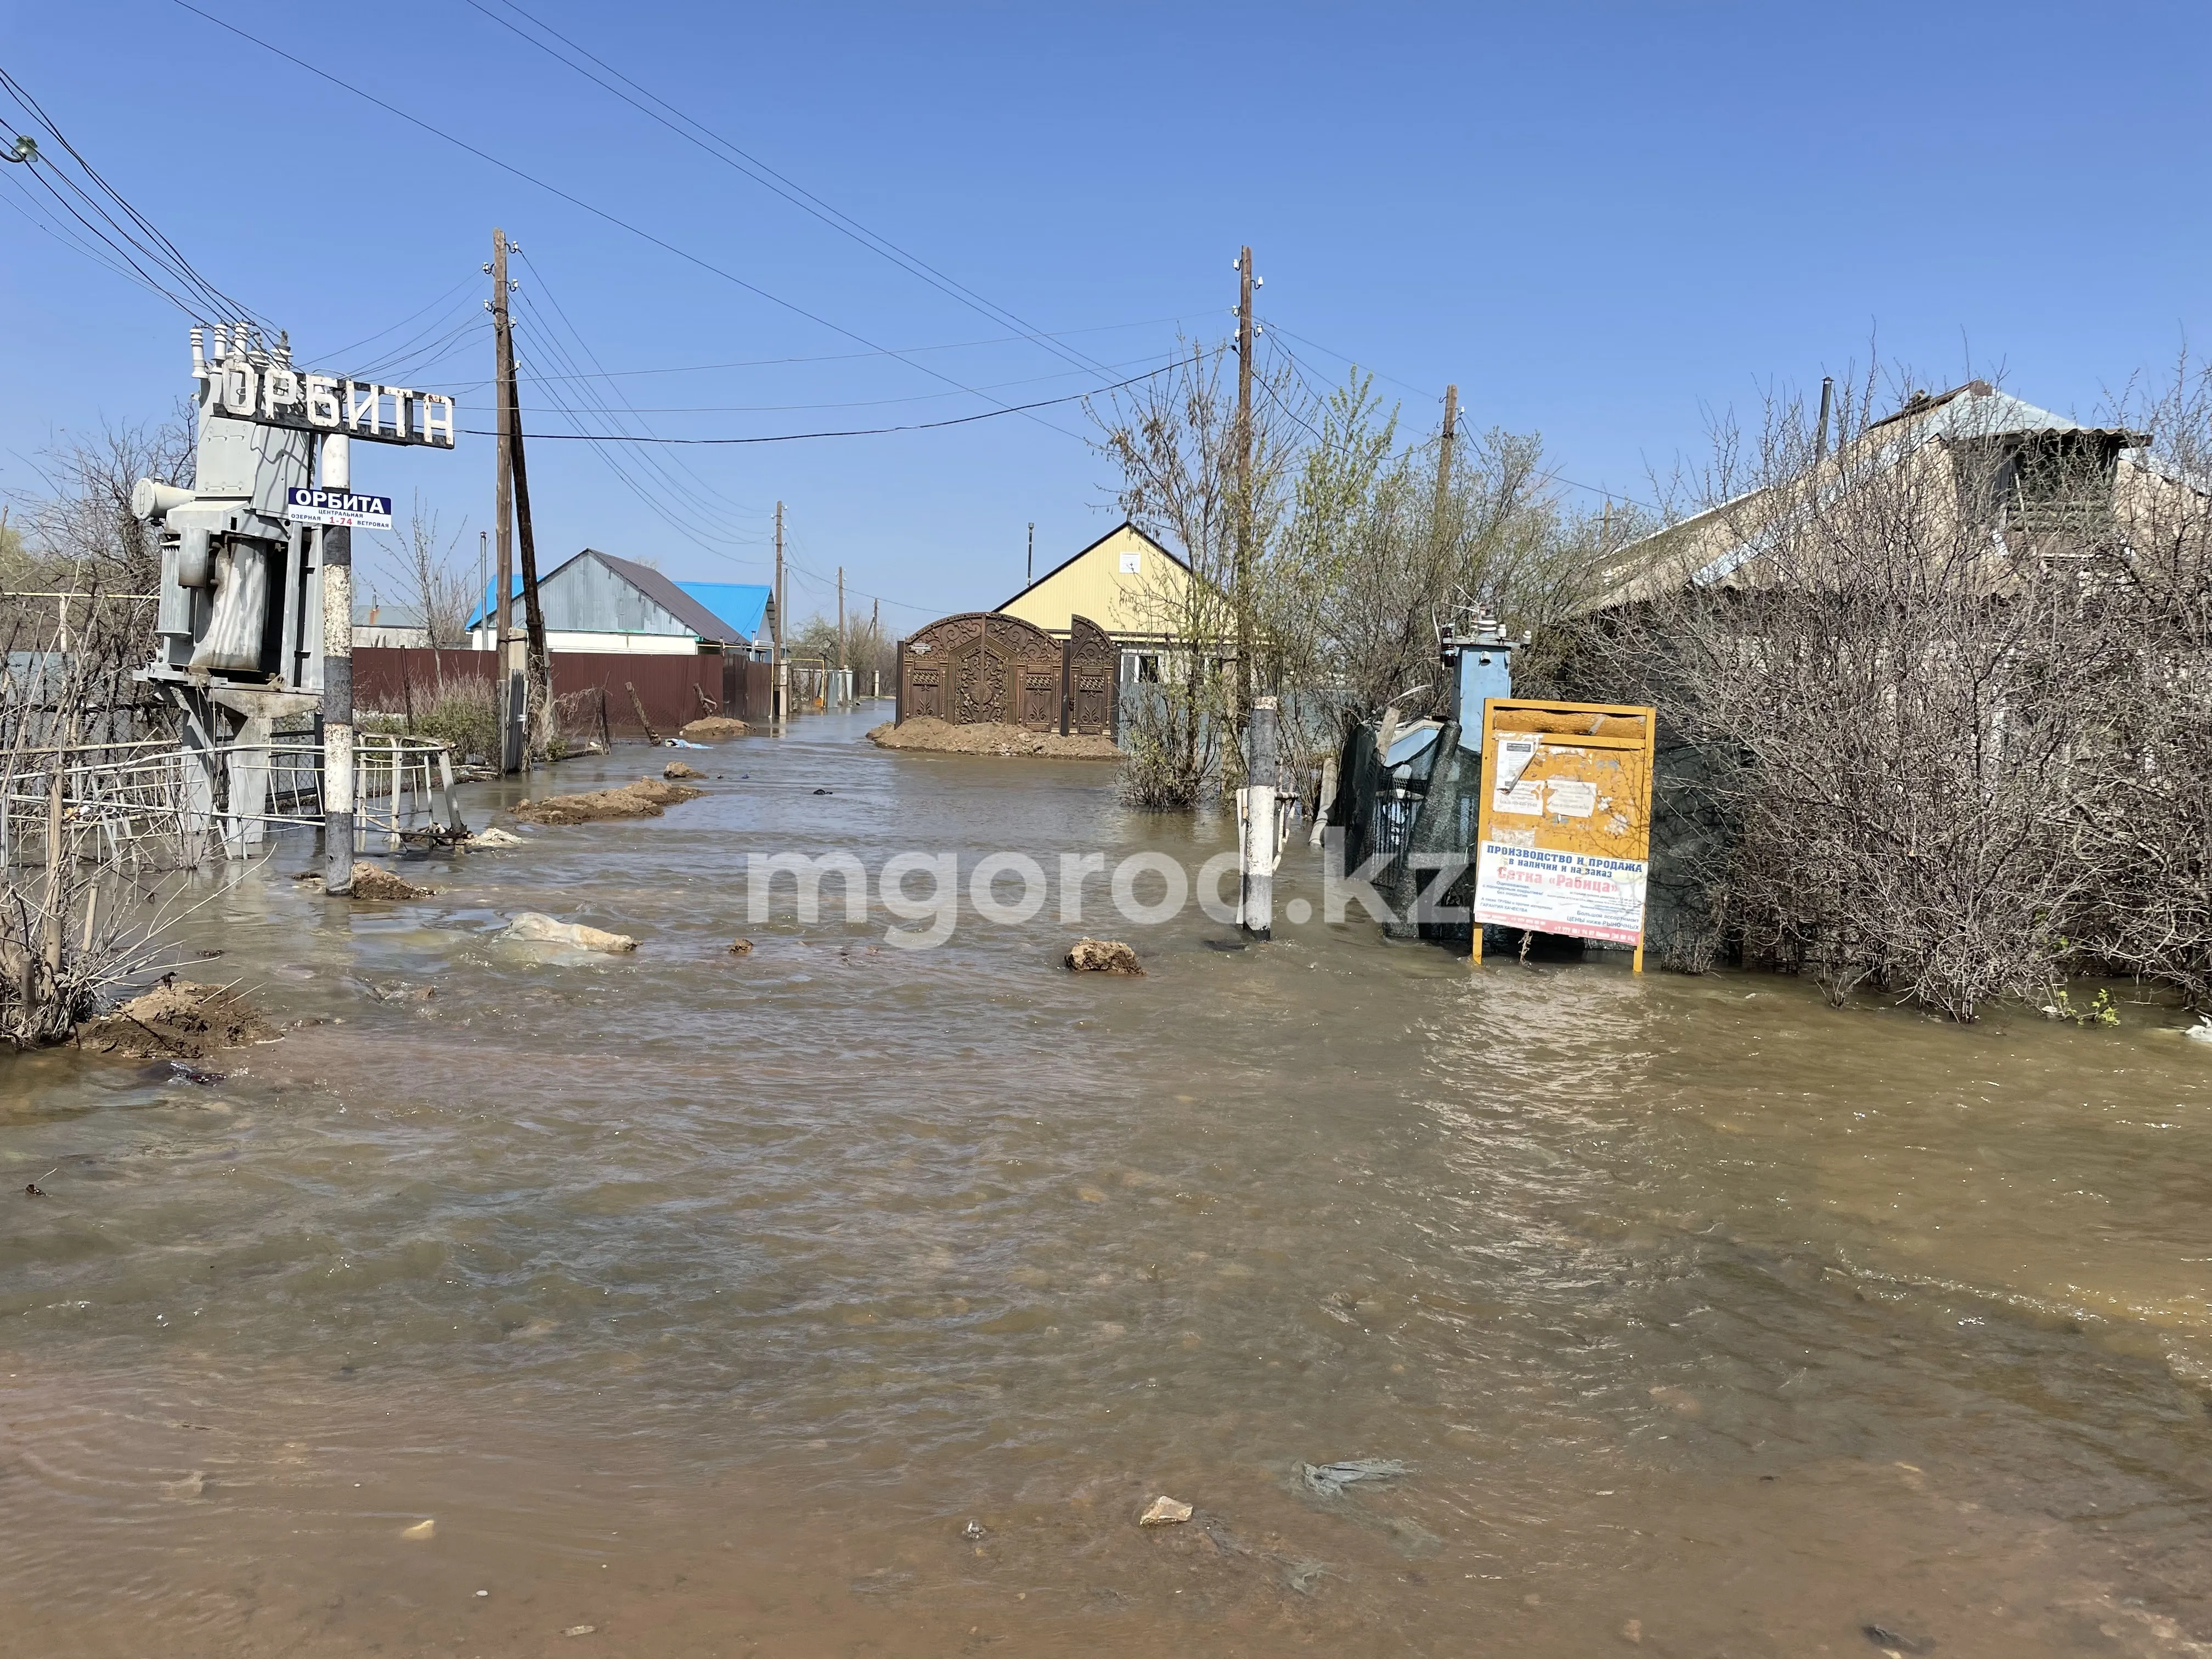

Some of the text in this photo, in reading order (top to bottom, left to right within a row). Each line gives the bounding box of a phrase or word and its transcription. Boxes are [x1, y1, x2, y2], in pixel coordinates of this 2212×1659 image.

[222, 358, 454, 446] ОРБИТА
[295, 489, 385, 514] ОРБИТА
[318, 509, 363, 518] ЦЕНТРАЛЬНАЯ
[329, 516, 352, 525] 1-74
[1487, 845, 1643, 872] ПРОИЗВОДСТВО И ПРОДАЖА
[1517, 859, 1558, 871] наличии
[1584, 868, 1612, 878] заказ
[1497, 867, 1618, 894] Сетка «Рабица»
[1602, 921, 1639, 930] РЫНОЧНЫХ
[1604, 915, 1639, 923] ассортимент
